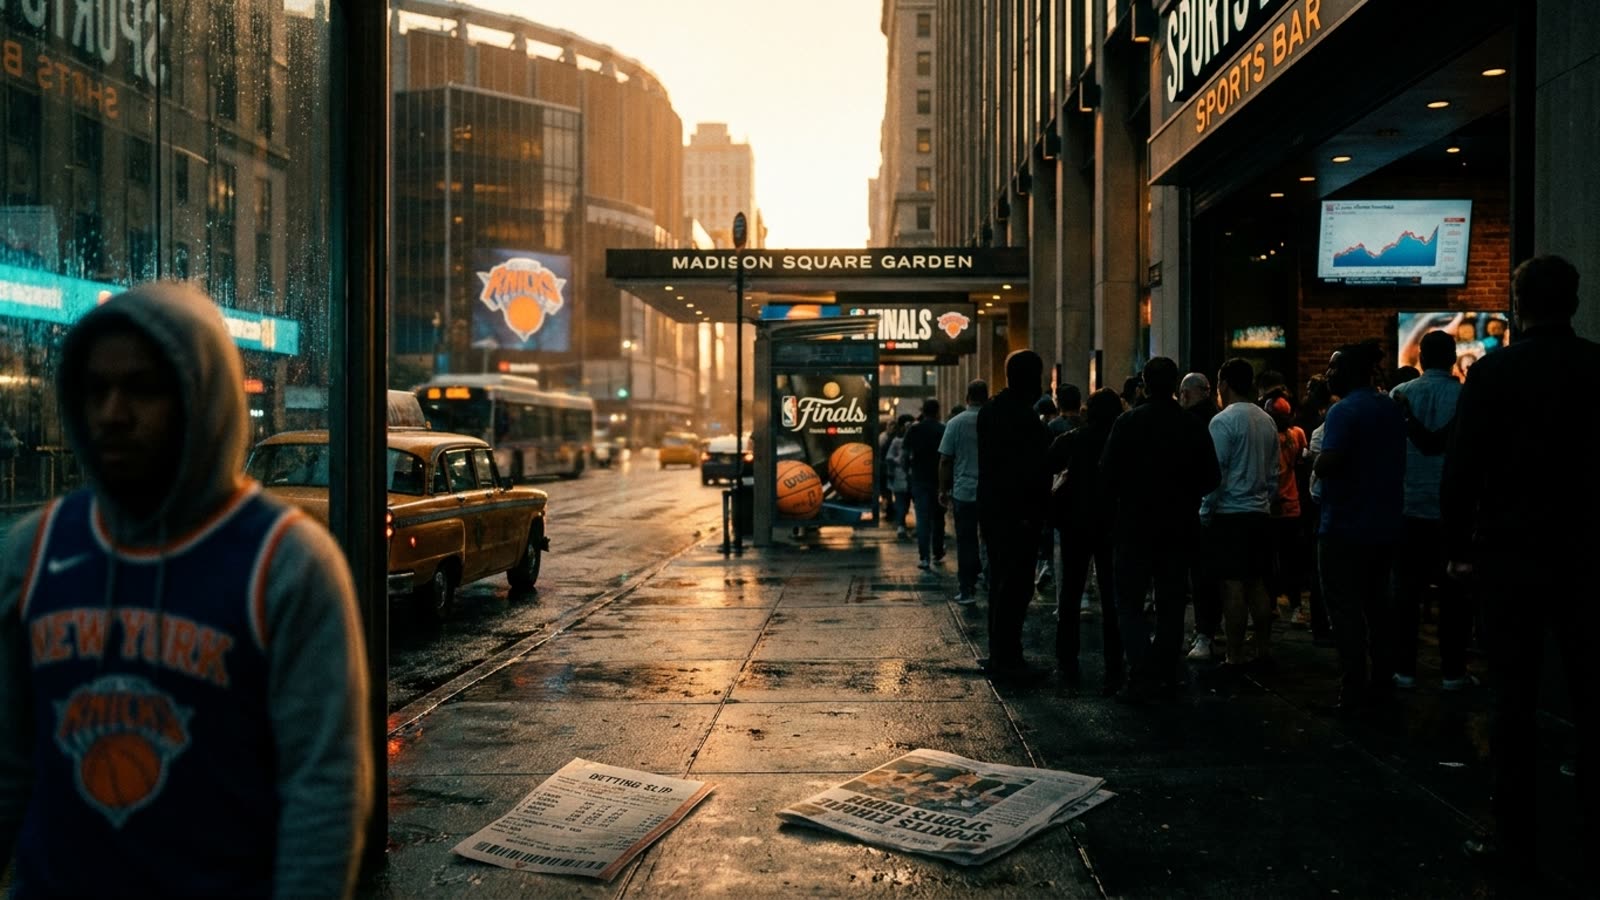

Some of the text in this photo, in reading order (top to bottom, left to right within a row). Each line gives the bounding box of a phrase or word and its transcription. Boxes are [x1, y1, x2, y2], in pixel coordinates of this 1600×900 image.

[1196, 0, 1321, 133] SPORTS BAR
[672, 255, 973, 270] MADISON SQUARE GARDEN
[790, 396, 867, 432] Finals
[31, 608, 111, 667] NEW
